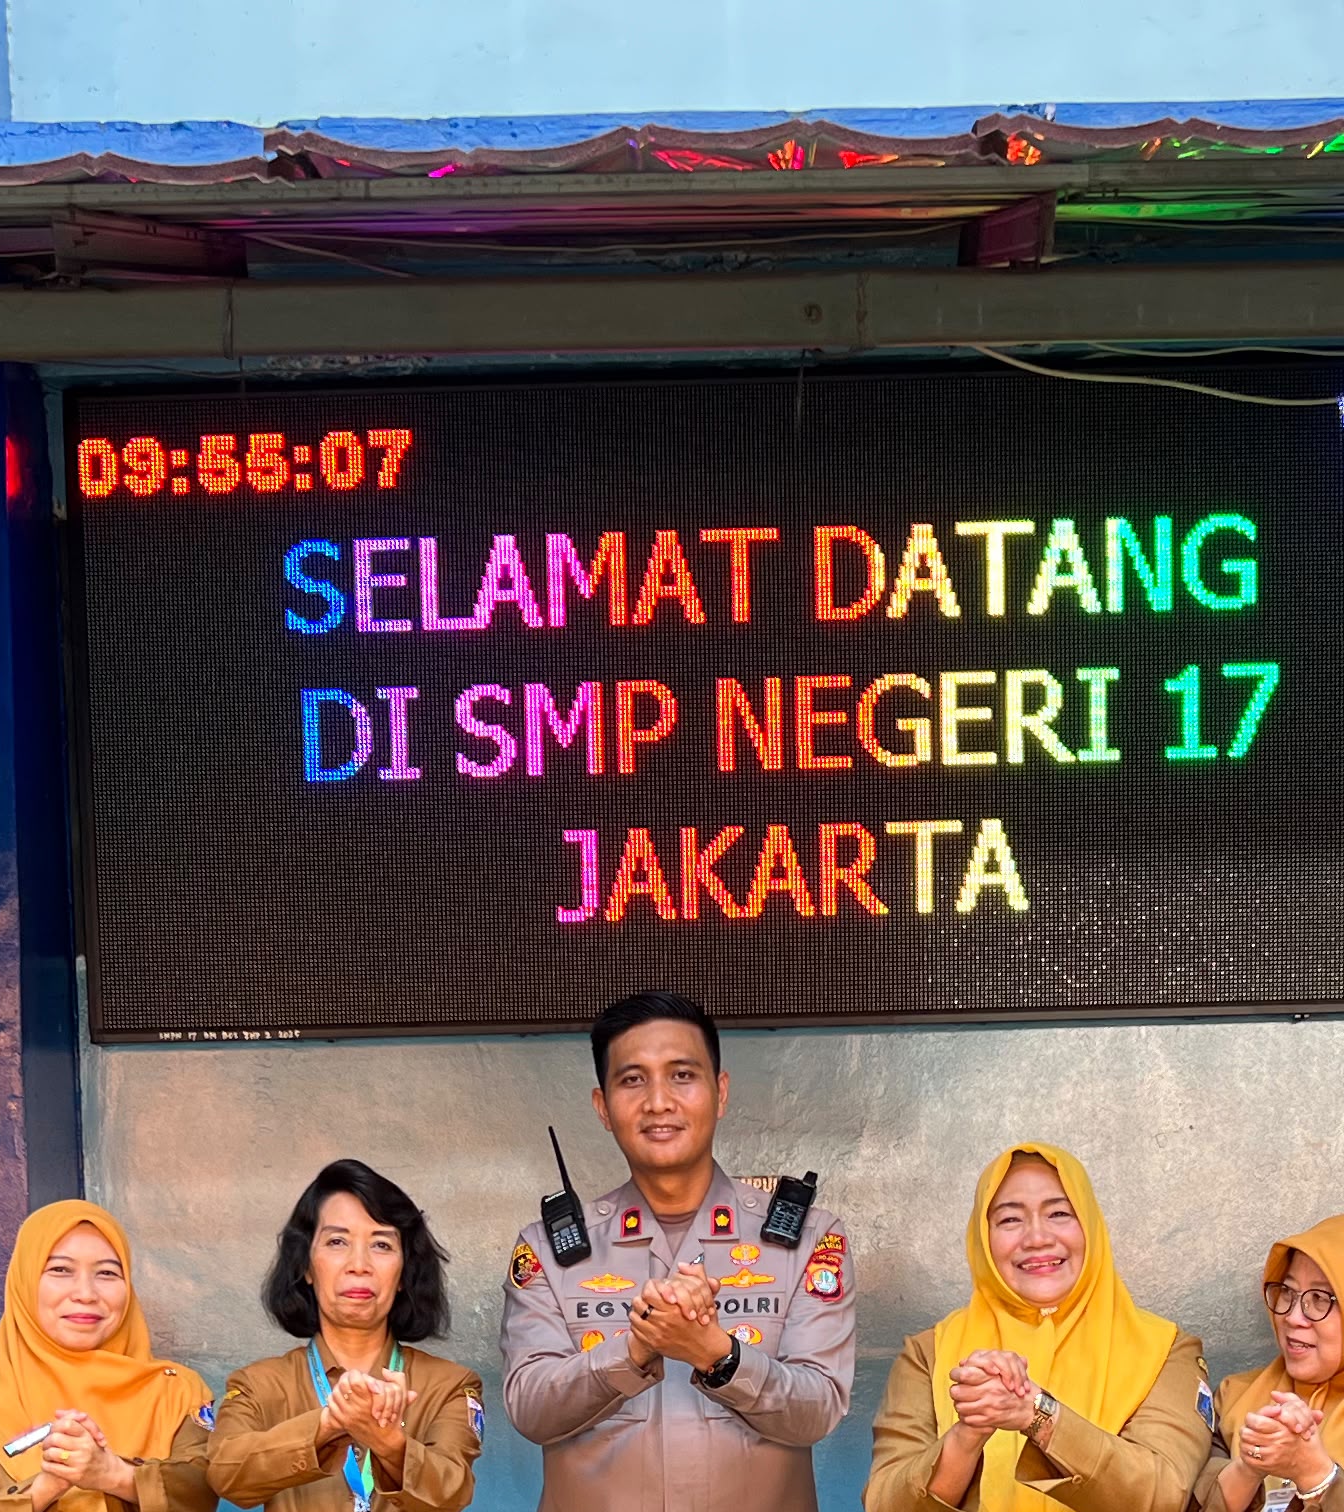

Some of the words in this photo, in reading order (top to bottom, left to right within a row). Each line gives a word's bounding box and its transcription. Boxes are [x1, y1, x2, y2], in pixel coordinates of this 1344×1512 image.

[77, 428, 413, 498] 09:55:07
[282, 523, 780, 635] SELAMAT
[811, 512, 1259, 623] DATANG
[301, 685, 422, 783] DI
[454, 680, 679, 780] SMP
[714, 666, 1122, 773] NEGERI
[1163, 661, 1282, 761] 17
[556, 817, 1031, 924] JAKARTA
